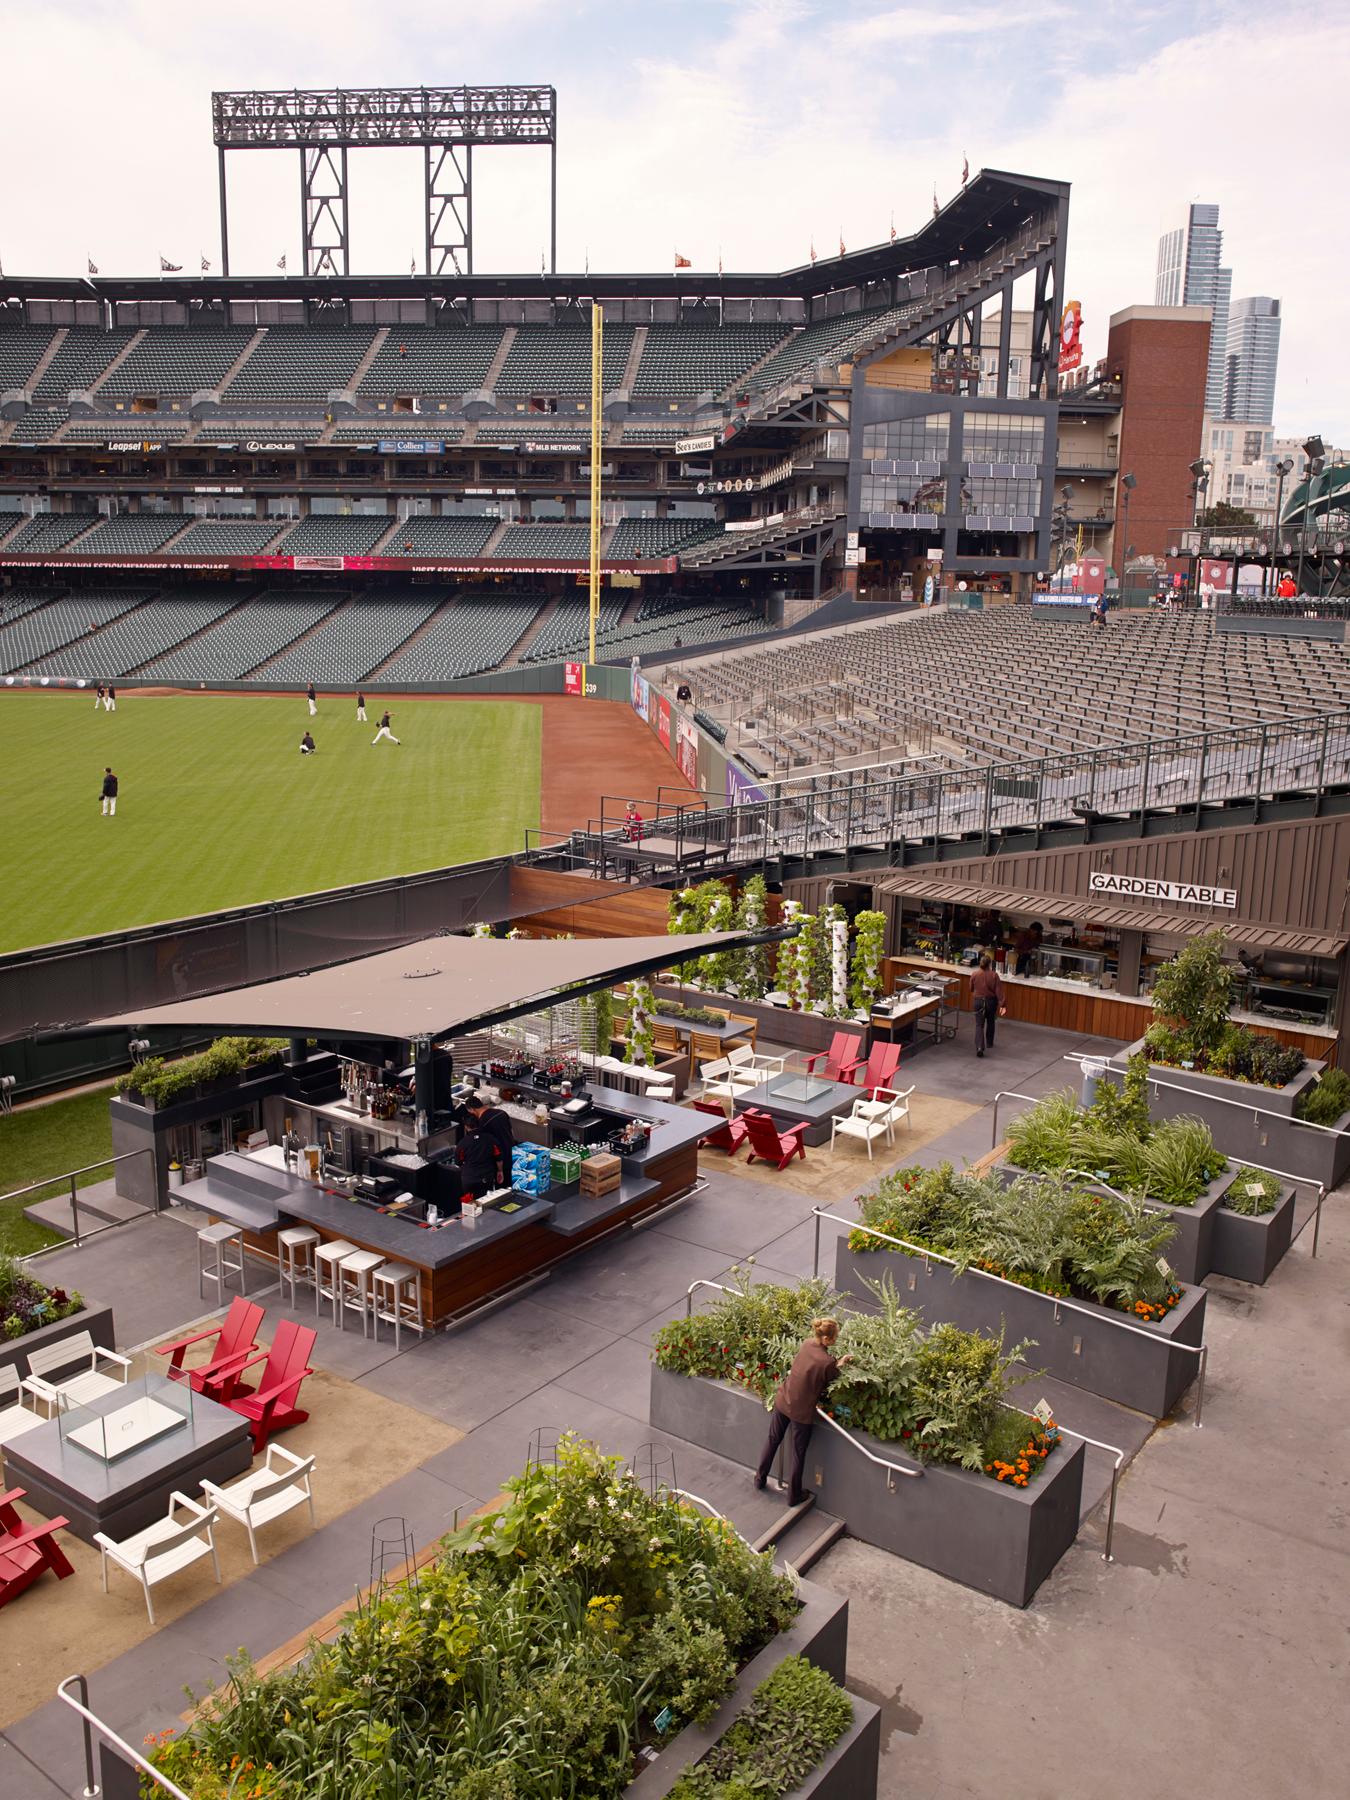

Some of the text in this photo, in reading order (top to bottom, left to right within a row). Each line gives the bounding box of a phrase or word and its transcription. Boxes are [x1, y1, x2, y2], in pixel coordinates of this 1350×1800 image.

[108, 441, 142, 452] Leapset
[397, 441, 424, 449] Colliers
[585, 683, 597, 693] 339
[1091, 874, 1236, 906] GARDEN TABLE
